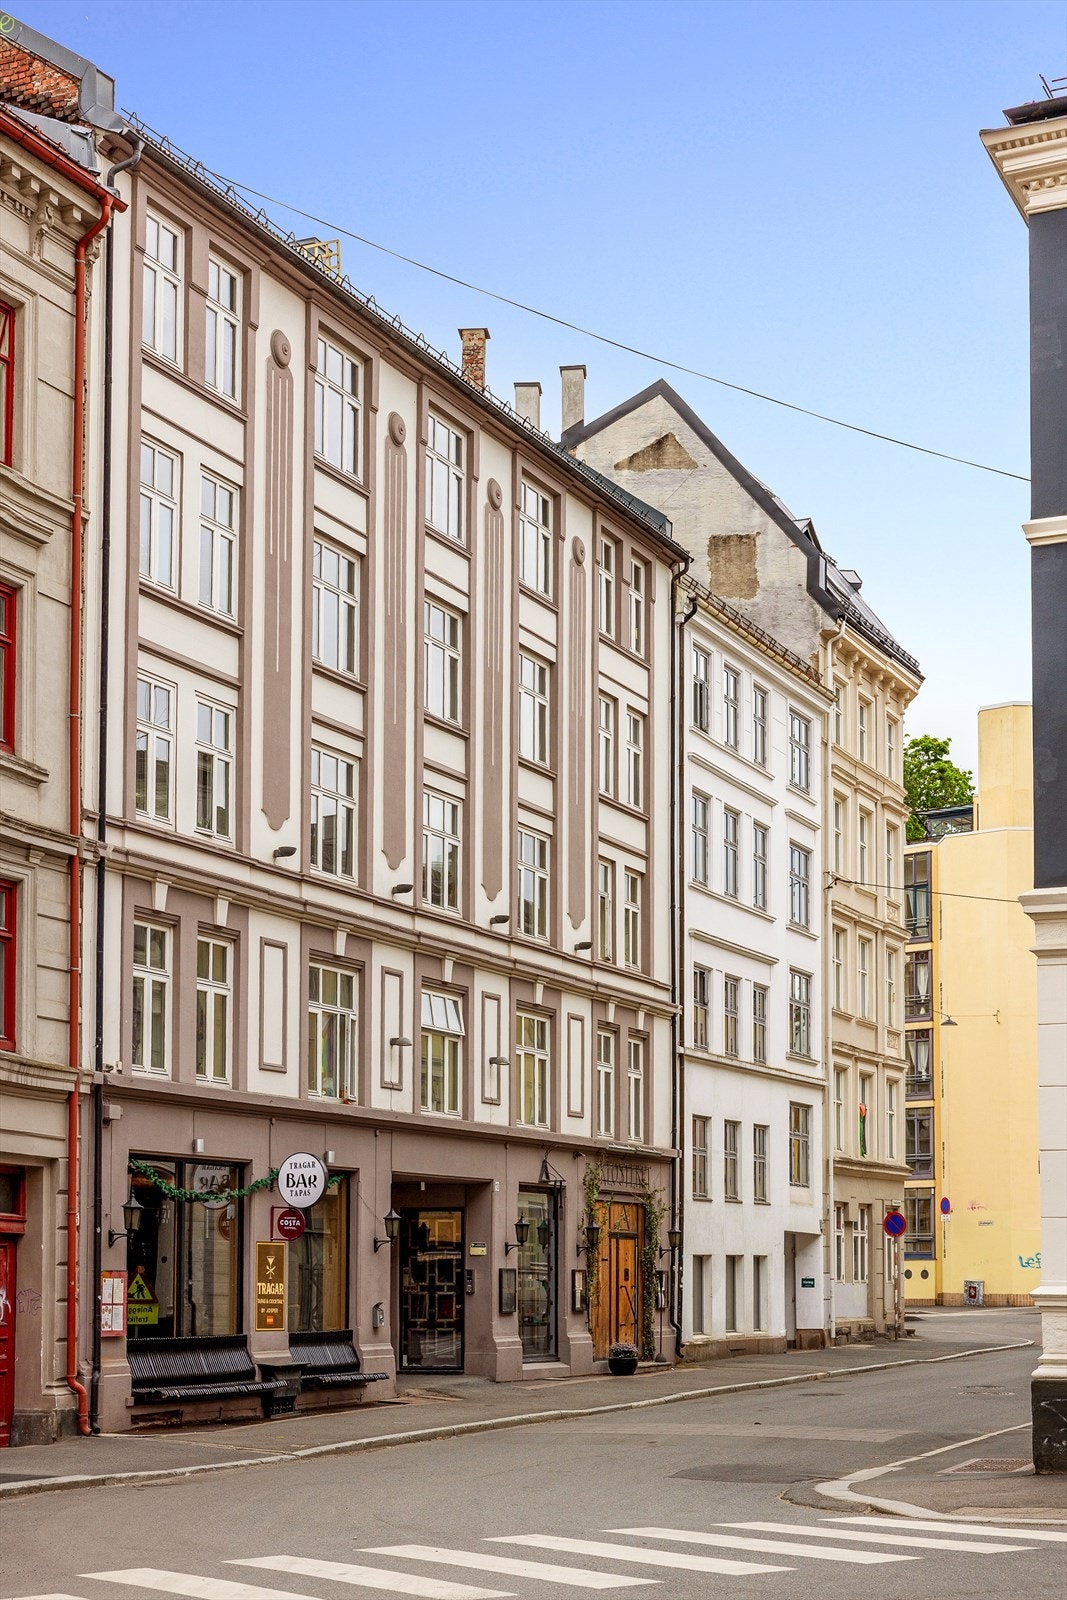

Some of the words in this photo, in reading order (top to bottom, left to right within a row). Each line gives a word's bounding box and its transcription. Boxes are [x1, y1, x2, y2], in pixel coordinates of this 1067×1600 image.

[289, 1161, 316, 1170] TRAGAR
[286, 1173, 318, 1189] BAR
[257, 1282, 284, 1295] TRAGAR
